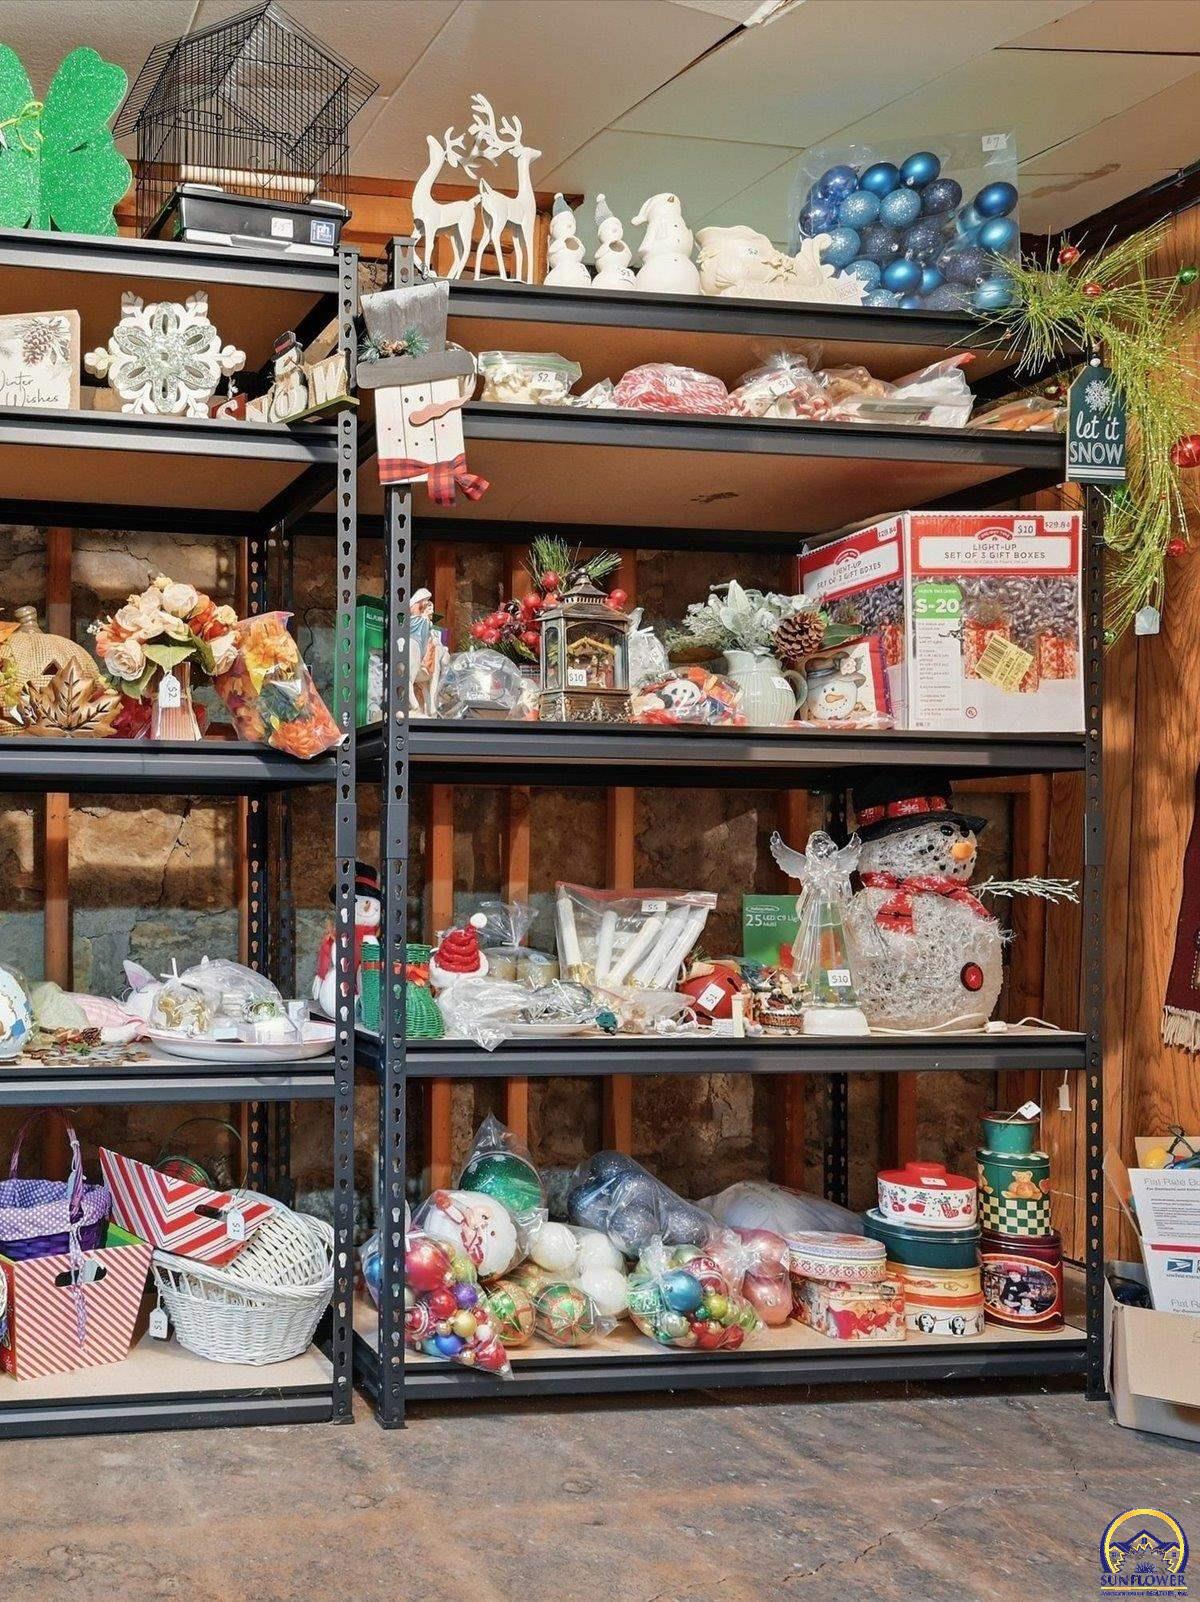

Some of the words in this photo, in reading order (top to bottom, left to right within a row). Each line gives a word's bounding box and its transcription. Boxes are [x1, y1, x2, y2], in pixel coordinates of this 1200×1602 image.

[6, 386, 59, 408] Wishes
[1076, 410, 1100, 439] let
[1104, 416, 1120, 440] it
[1069, 441, 1124, 465] SNOW
[1017, 524, 1034, 535] $10
[972, 543, 1017, 551] LIGHT-UP
[944, 551, 960, 559] SET
[964, 551, 978, 559] OF
[981, 551, 986, 559] 3
[989, 551, 1010, 559] GIFT
[1013, 551, 1046, 559] BOXES
[569, 672, 584, 682] $10
[745, 914, 762, 927] 25
[831, 974, 849, 985] $10
